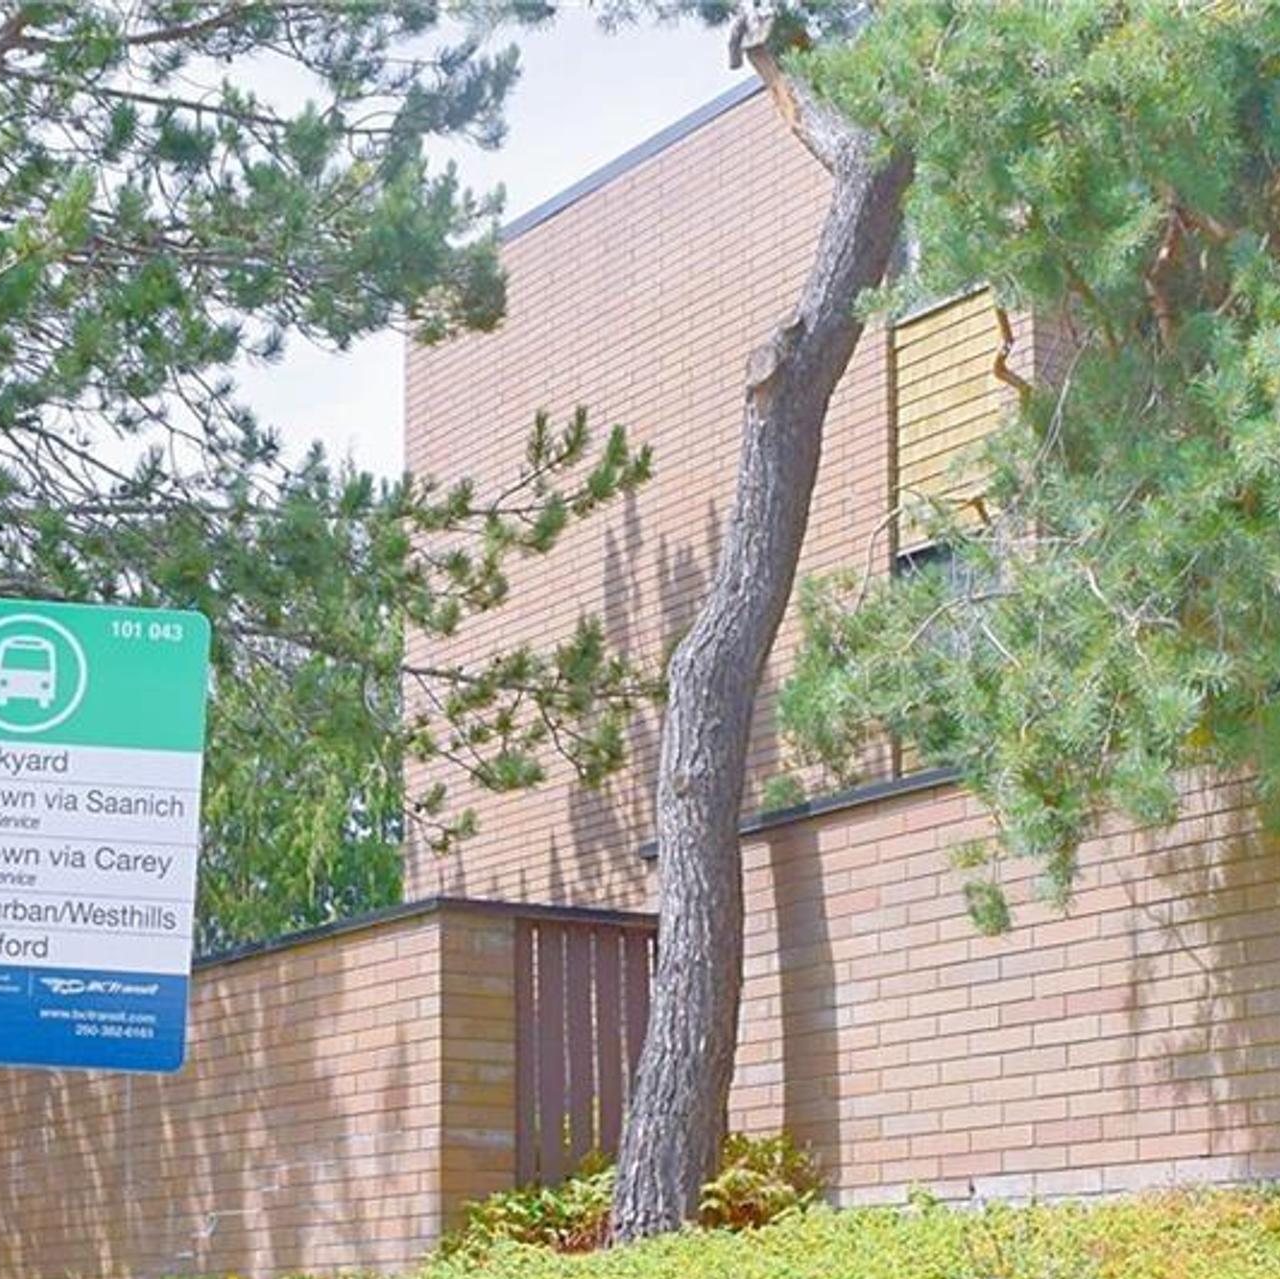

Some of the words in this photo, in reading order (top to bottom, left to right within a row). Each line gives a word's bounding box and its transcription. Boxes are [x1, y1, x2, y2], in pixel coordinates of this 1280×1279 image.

[112, 621, 141, 639] 101
[148, 622, 183, 642] 043
[44, 788, 78, 812] via
[86, 789, 185, 817] Saanich
[49, 845, 86, 868] via
[94, 846, 173, 880] Carey
